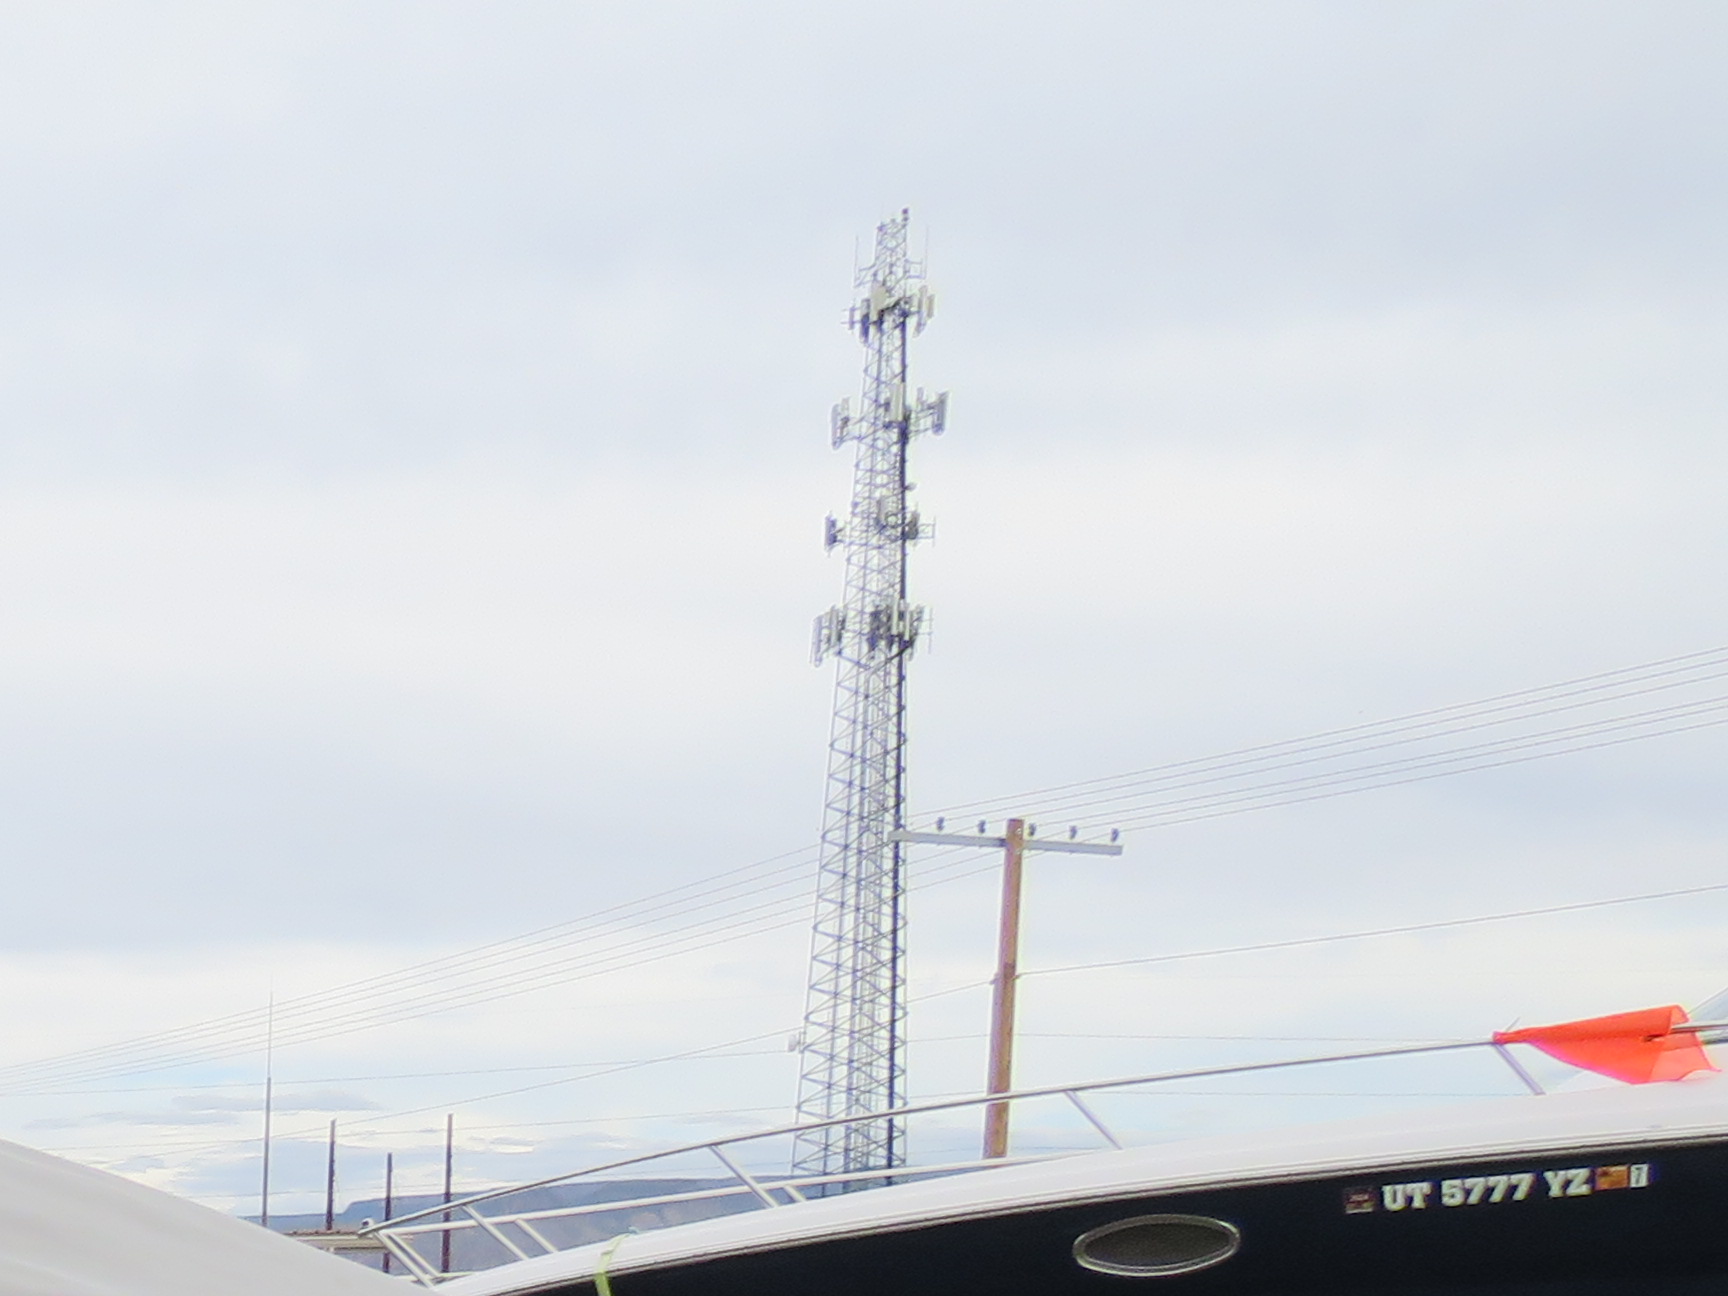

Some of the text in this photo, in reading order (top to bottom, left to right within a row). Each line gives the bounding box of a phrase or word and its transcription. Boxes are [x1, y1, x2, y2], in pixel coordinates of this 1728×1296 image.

[1382, 1182, 1432, 1212] UT
[1441, 1173, 1536, 1208] 5777
[1544, 1167, 1593, 1199] YZ
